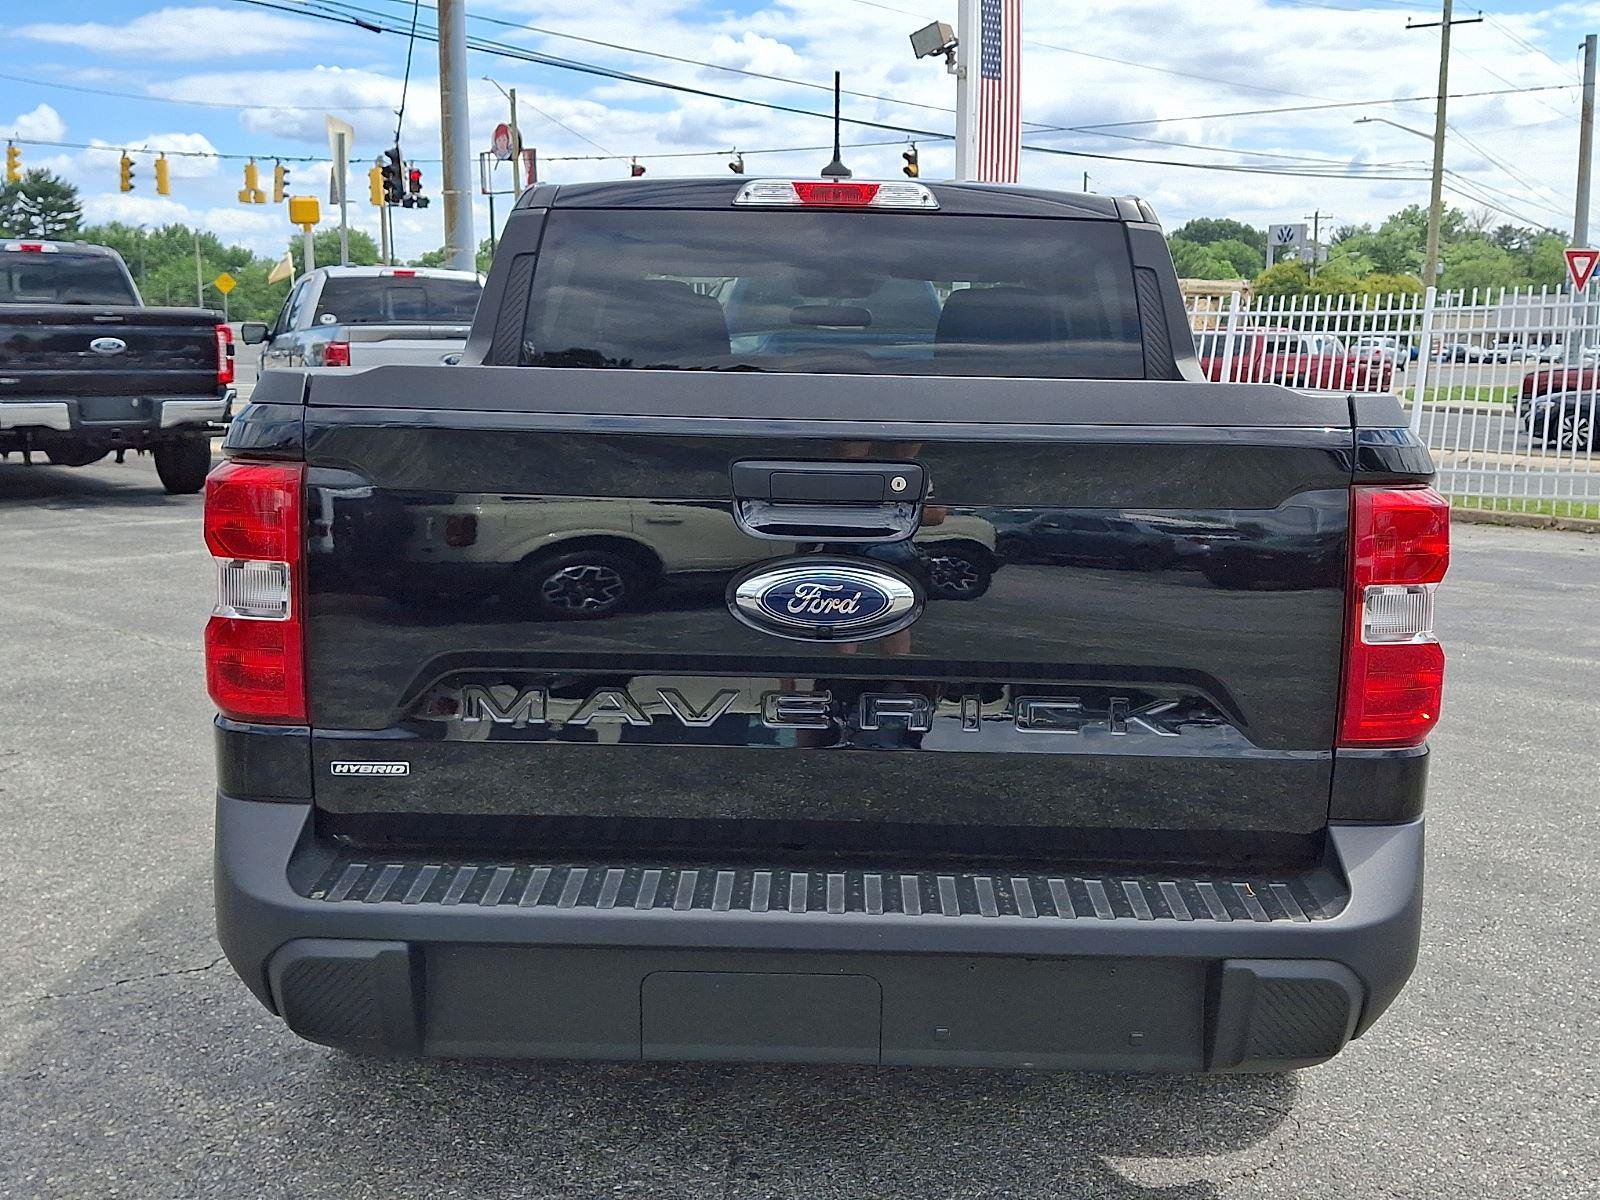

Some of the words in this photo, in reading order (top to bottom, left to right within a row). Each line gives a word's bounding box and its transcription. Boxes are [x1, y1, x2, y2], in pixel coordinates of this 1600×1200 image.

[787, 583, 861, 614] Ford
[461, 686, 1181, 737] MAVERICK
[334, 764, 405, 774] HYBRID
